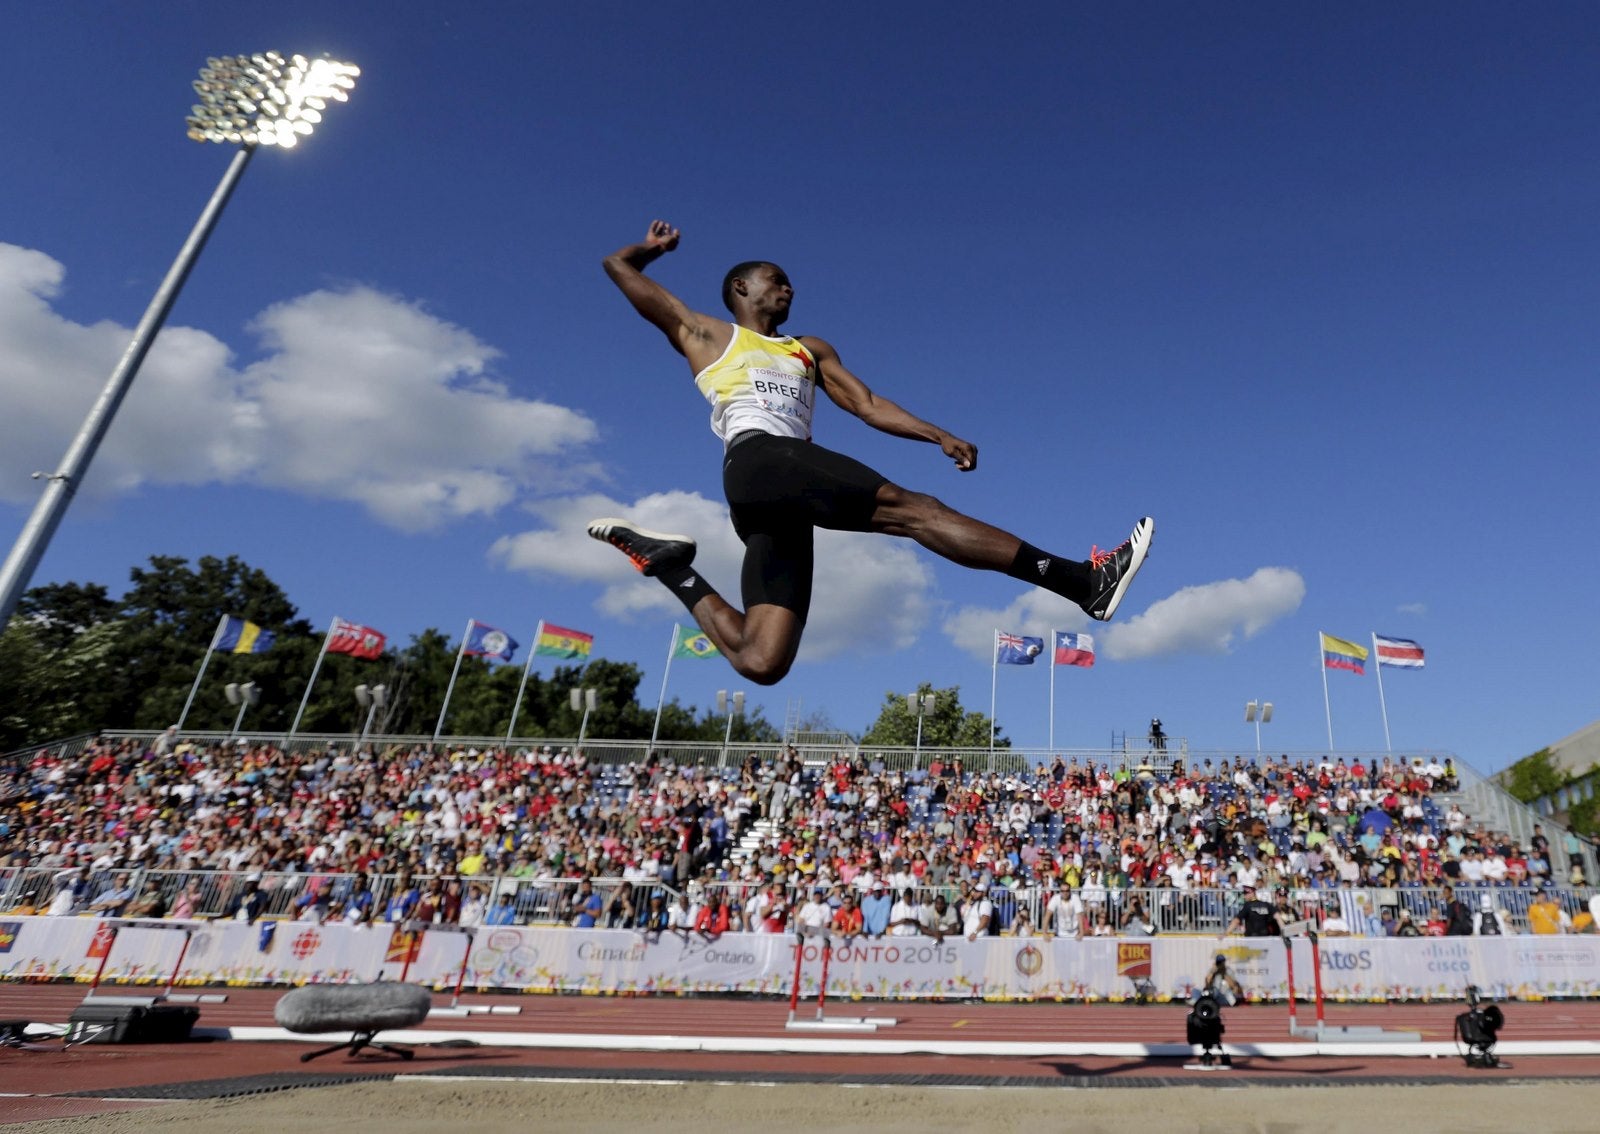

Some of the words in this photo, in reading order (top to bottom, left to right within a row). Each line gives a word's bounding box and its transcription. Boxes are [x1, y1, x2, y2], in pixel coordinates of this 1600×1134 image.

[754, 380, 810, 409] BREELL
[578, 941, 645, 961] Canada
[704, 950, 755, 964] Ontario
[1119, 944, 1149, 959] CIBC
